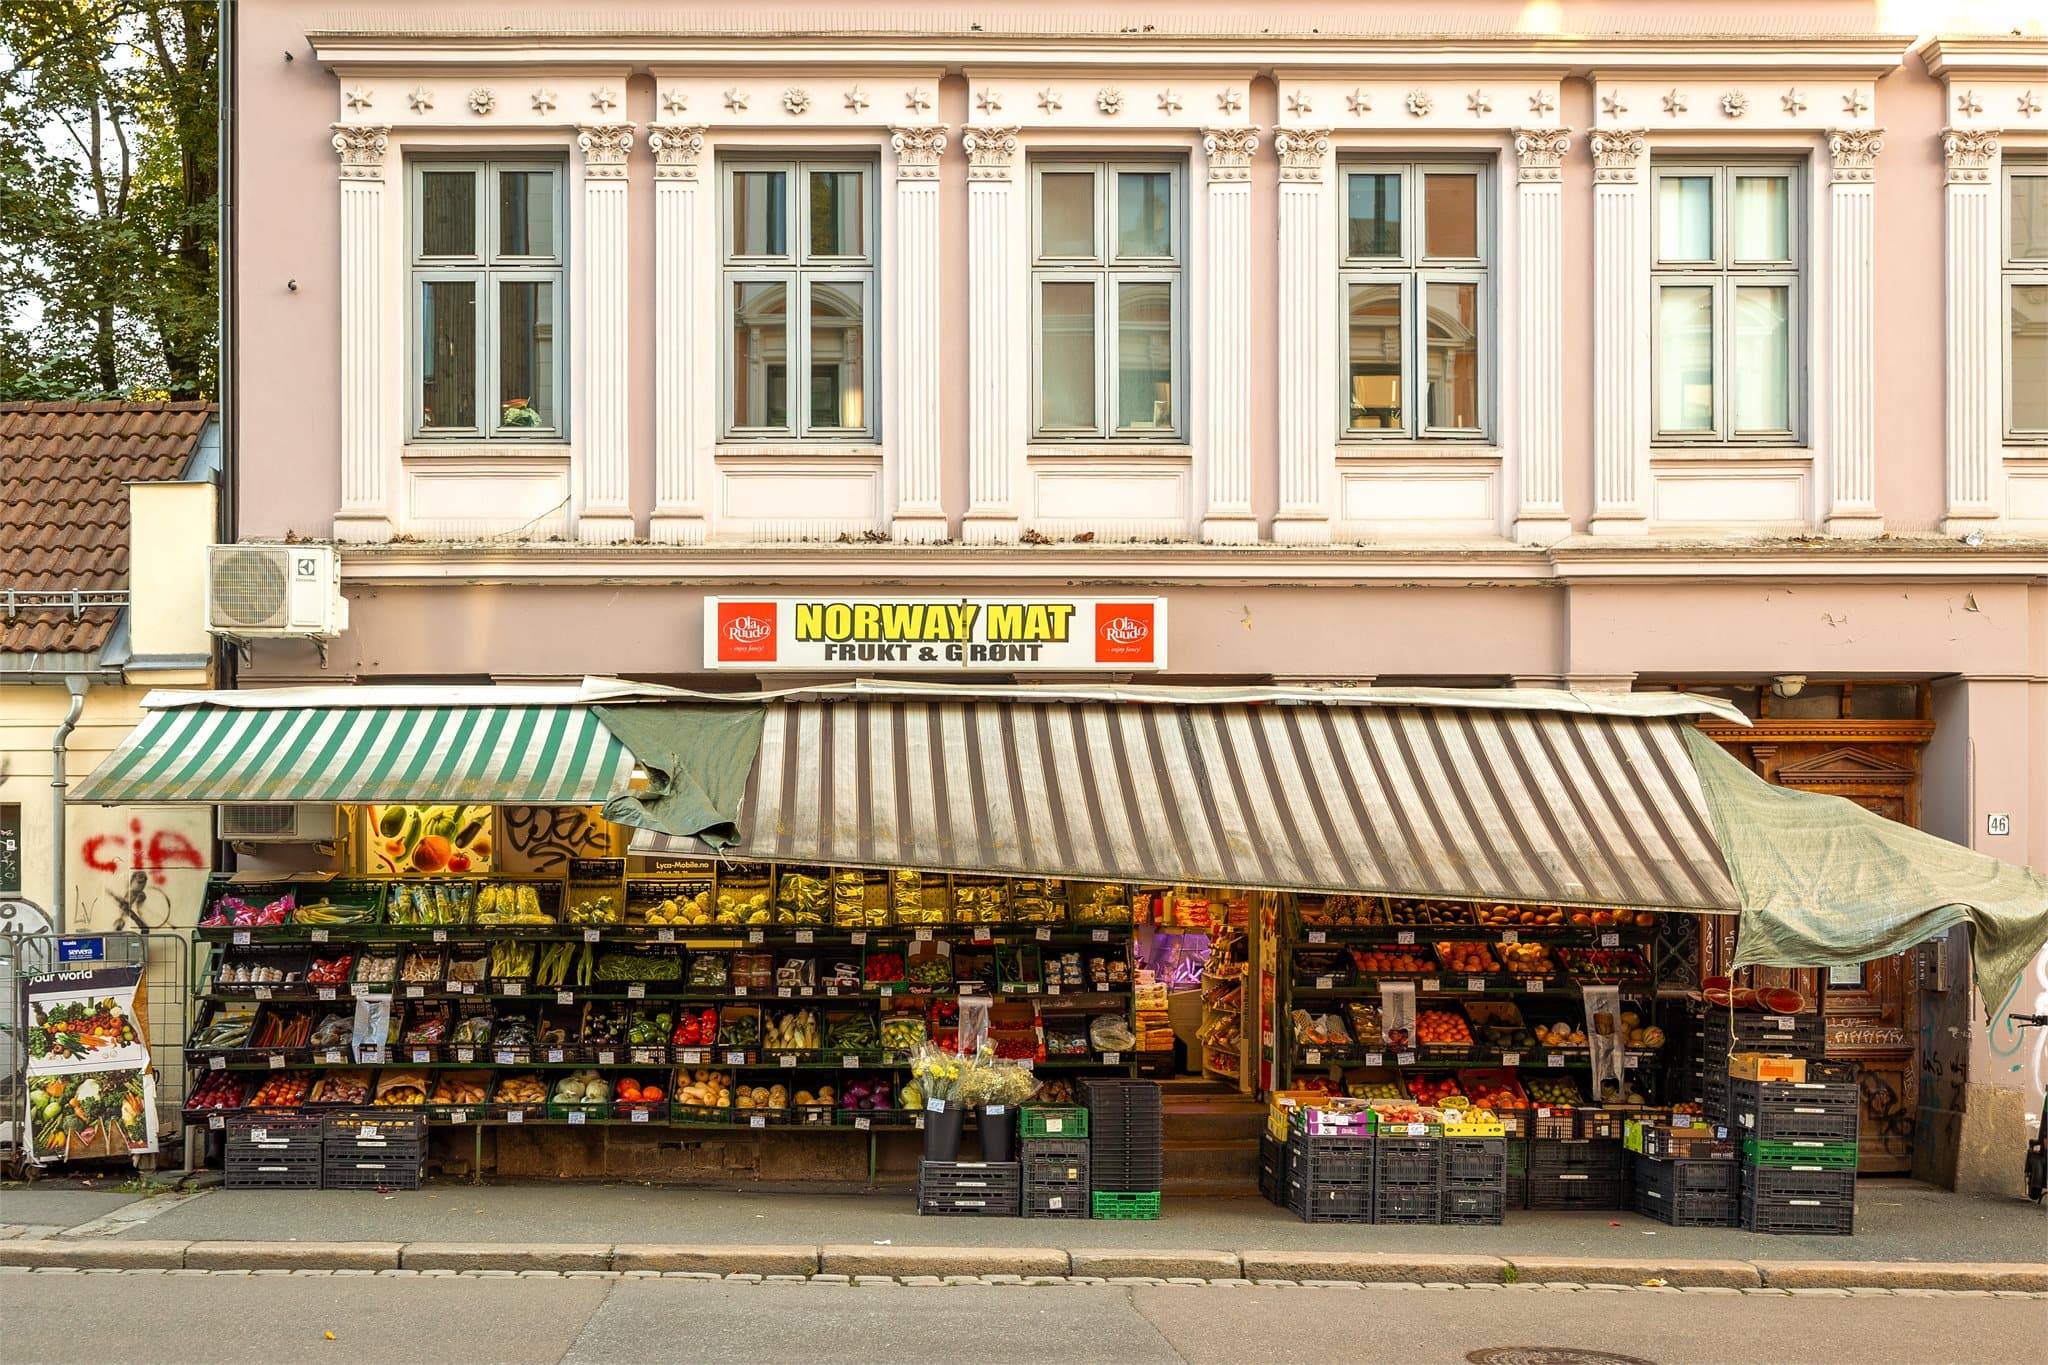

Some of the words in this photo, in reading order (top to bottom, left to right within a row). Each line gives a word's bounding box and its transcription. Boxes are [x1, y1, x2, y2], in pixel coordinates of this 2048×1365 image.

[735, 615, 757, 630] Ola
[795, 603, 982, 642] NORWAY
[986, 604, 1076, 642] MAT
[1112, 616, 1135, 631] Ola
[824, 643, 912, 662] FRUKT
[918, 645, 938, 662] &
[945, 643, 1043, 662] GRØNT
[1991, 817, 2006, 832] 46
[656, 861, 709, 870] Lyca-Mobile.no
[29, 973, 55, 986] your
[58, 970, 93, 981] world
